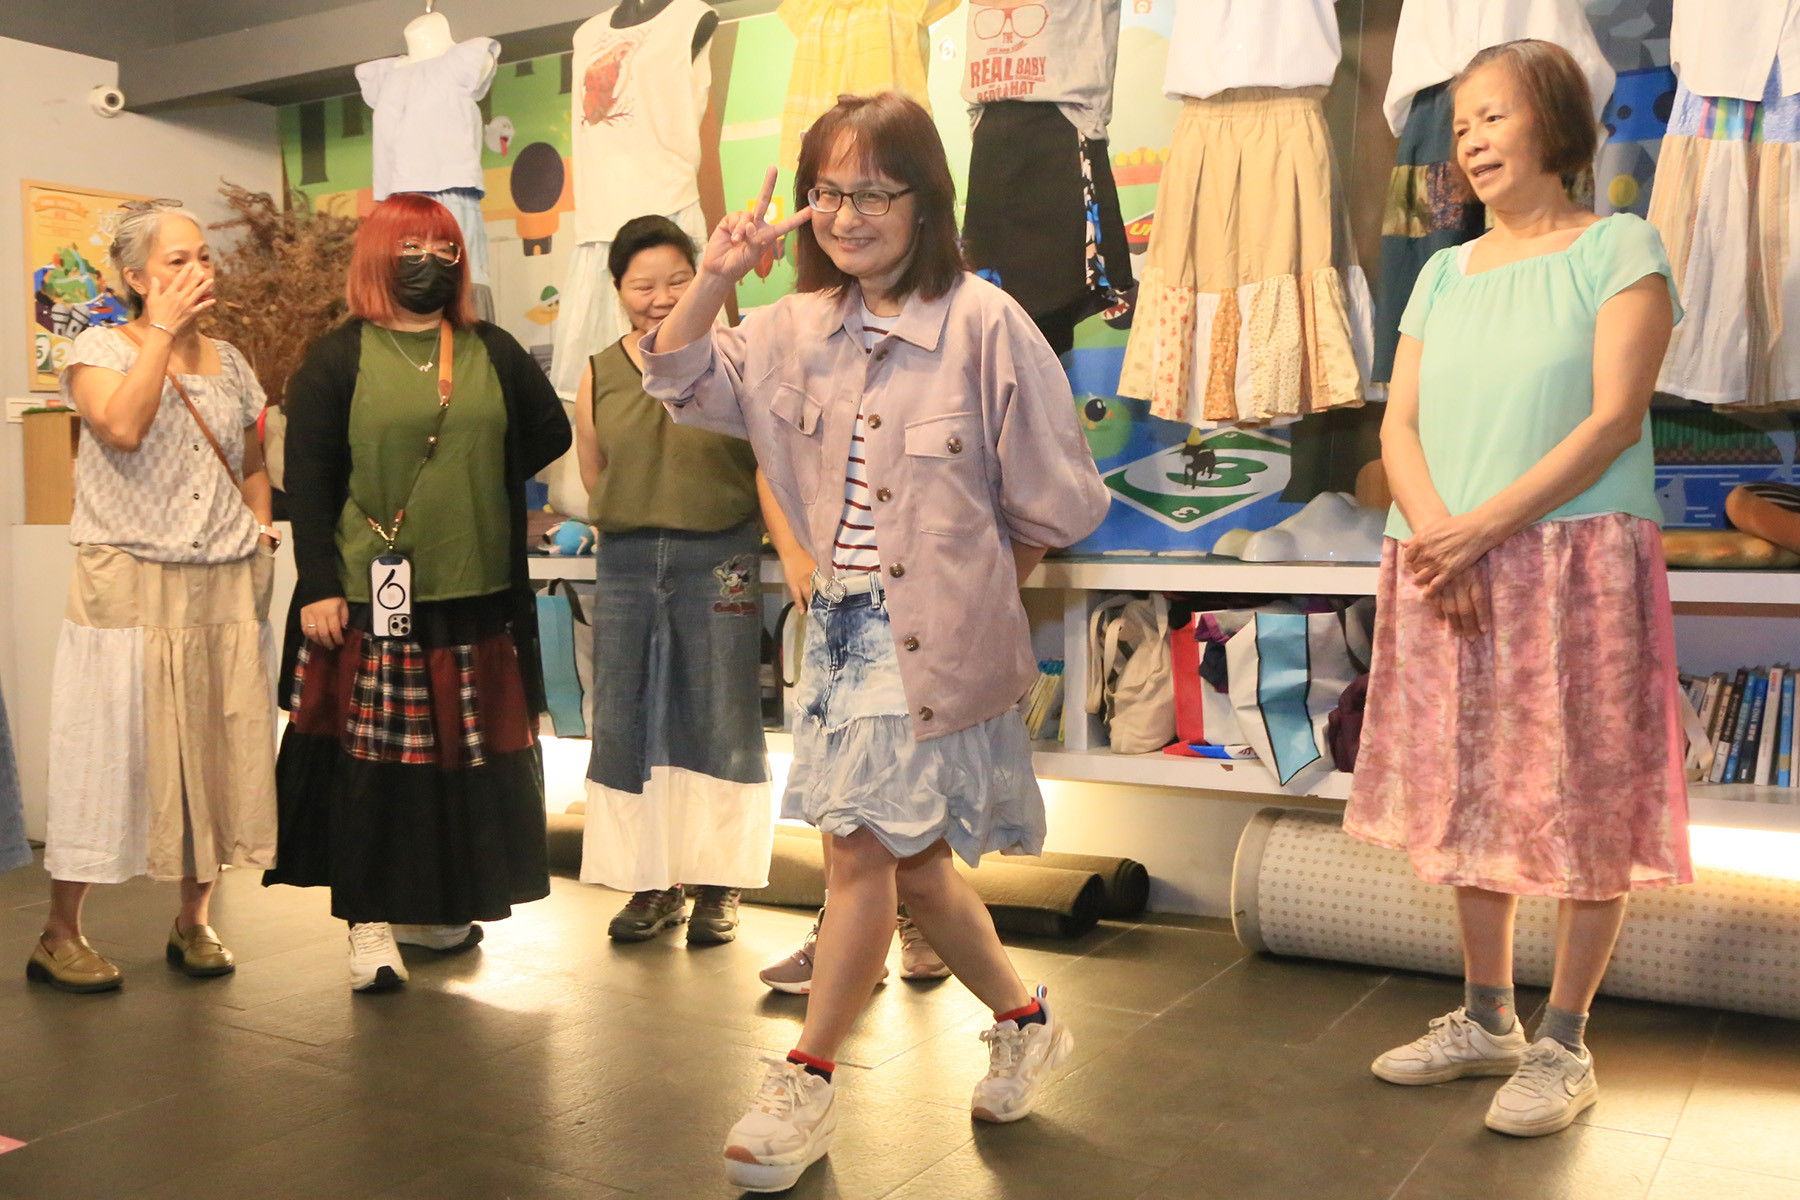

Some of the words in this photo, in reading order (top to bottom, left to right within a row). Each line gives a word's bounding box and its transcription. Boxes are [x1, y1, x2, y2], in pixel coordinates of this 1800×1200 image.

[970, 56, 1013, 89] REAL
[1016, 56, 1047, 76] BABY
[1010, 80, 1036, 96] HAT
[53, 347, 66, 362] 2
[377, 568, 405, 610] 6
